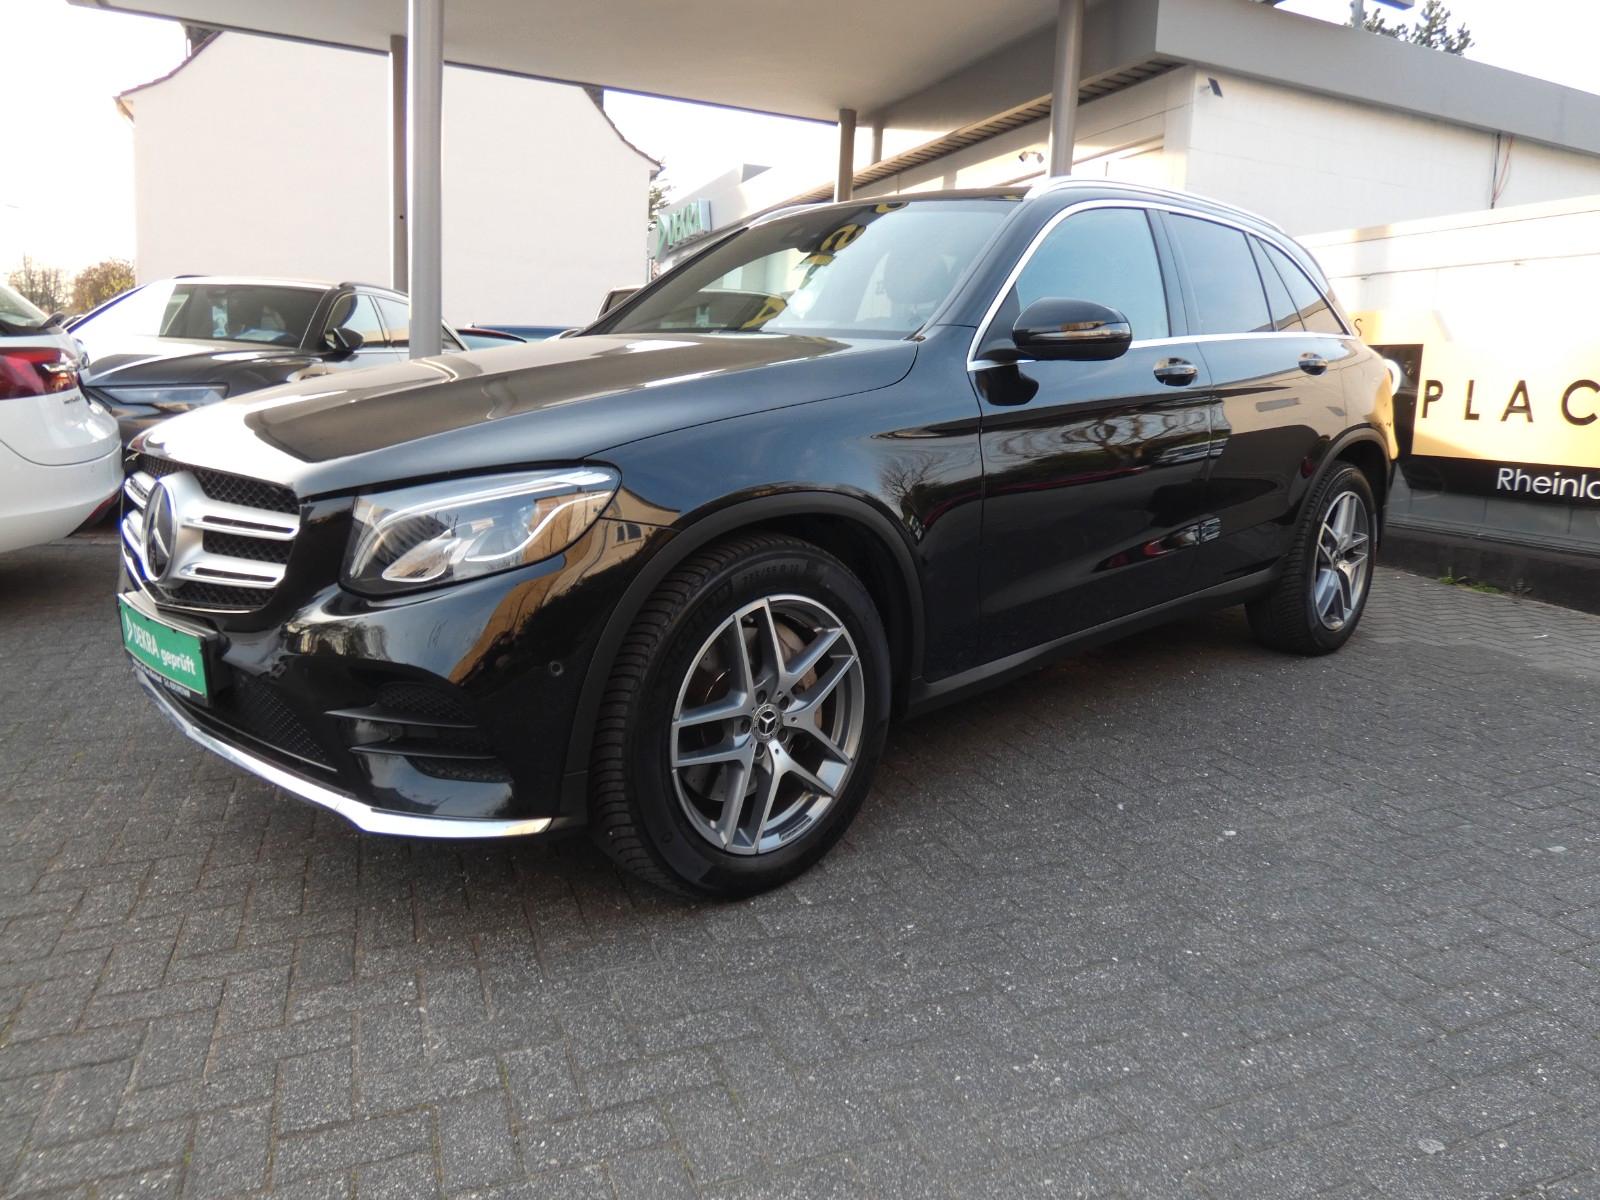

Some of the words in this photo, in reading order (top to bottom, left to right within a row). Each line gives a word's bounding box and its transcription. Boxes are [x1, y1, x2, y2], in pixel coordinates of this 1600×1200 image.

[1421, 379, 1600, 426] PLAC
[132, 623, 160, 658] DEKRA
[160, 648, 196, 676] geprüft
